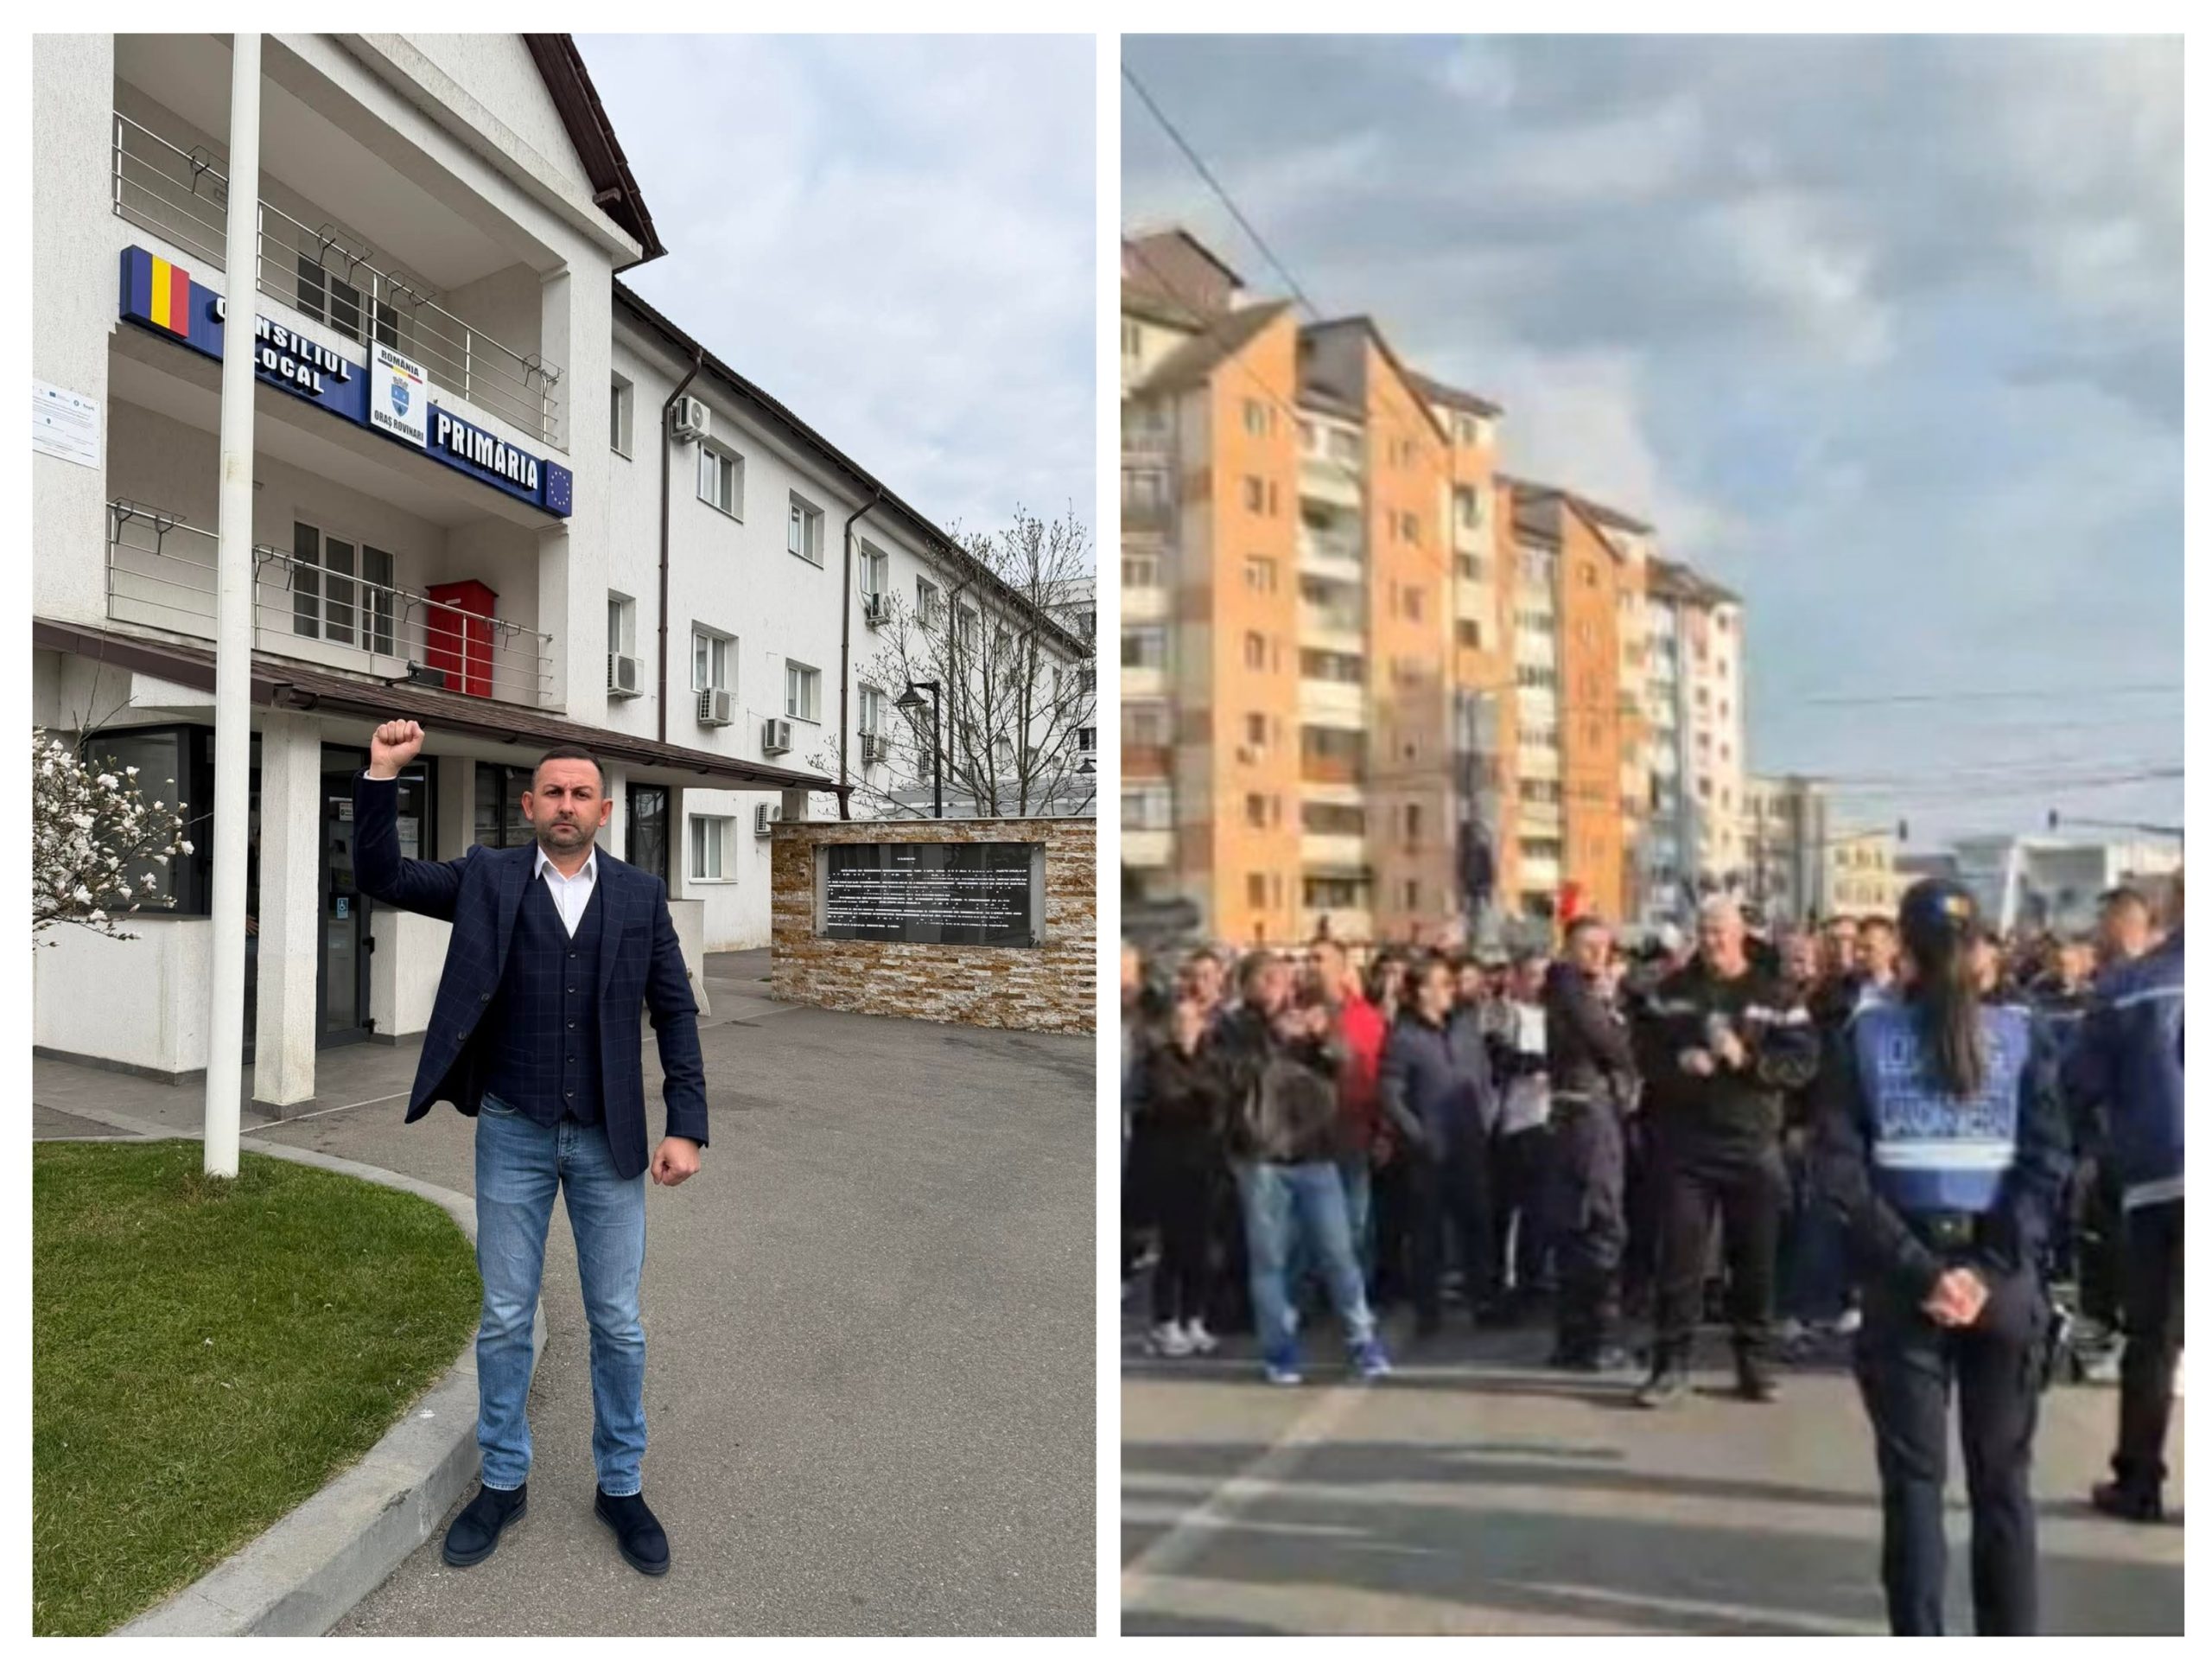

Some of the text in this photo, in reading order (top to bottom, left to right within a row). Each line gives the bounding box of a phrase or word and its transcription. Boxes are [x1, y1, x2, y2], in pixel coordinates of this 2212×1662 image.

[216, 296, 352, 380] CNSILIUL
[255, 347, 325, 394] OCAL
[380, 349, 419, 377] ROMÂNIA
[393, 419, 424, 443] ROVINARI
[437, 412, 538, 490] PRIMĂRIA
